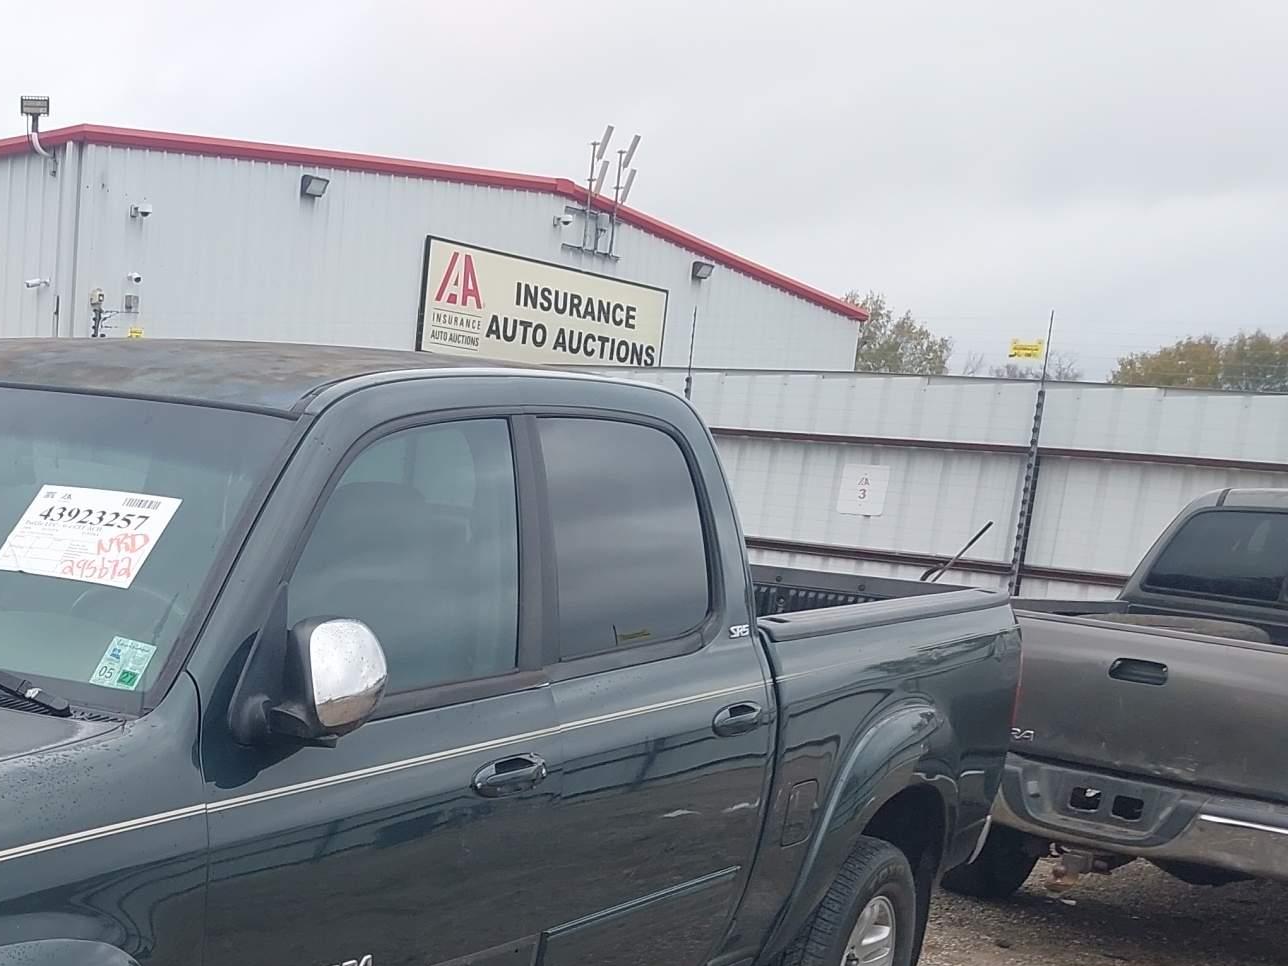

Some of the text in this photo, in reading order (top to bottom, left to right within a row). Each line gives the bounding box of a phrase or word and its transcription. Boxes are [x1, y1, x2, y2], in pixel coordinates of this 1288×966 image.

[515, 282, 637, 330] INSURANCE
[432, 312, 481, 330] INSURANCE
[430, 330, 480, 347] AUTO AUCTIONS
[485, 315, 656, 367] AUTO AUCTIONS
[858, 488, 866, 500] 3
[39, 505, 150, 531] 43923257
[98, 665, 115, 679] 05
